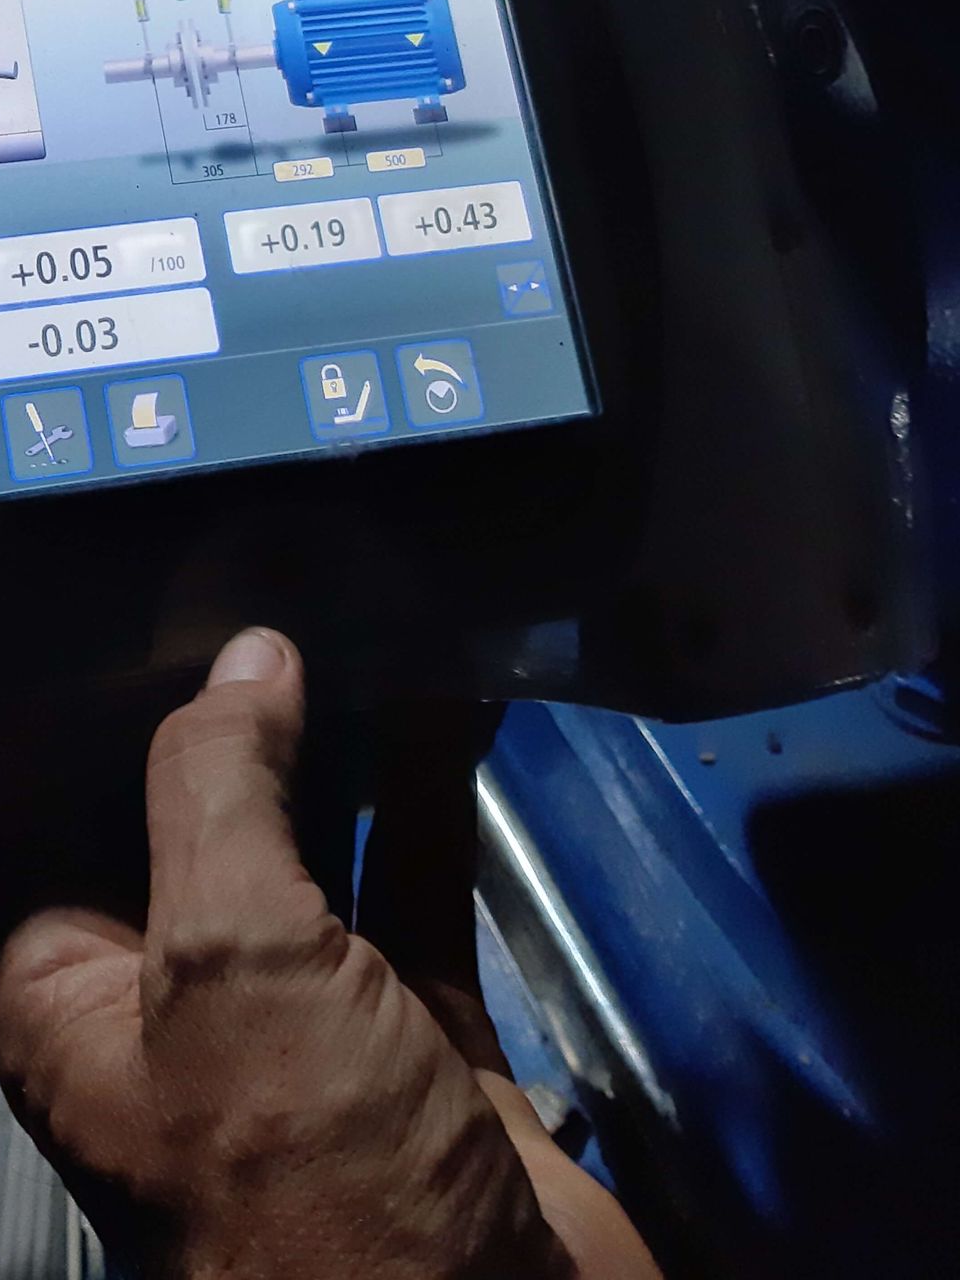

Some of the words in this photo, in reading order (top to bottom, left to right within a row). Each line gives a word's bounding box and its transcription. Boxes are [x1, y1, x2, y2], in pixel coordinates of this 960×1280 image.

[215, 113, 237, 126] 178
[203, 165, 224, 178] 305
[292, 164, 314, 176] 292
[385, 154, 406, 166] 500
[415, 202, 499, 235] +0.43
[261, 219, 346, 254] +0.19
[11, 245, 113, 287] +0.05
[151, 255, 186, 274] /100
[28, 317, 119, 358] -0.03
